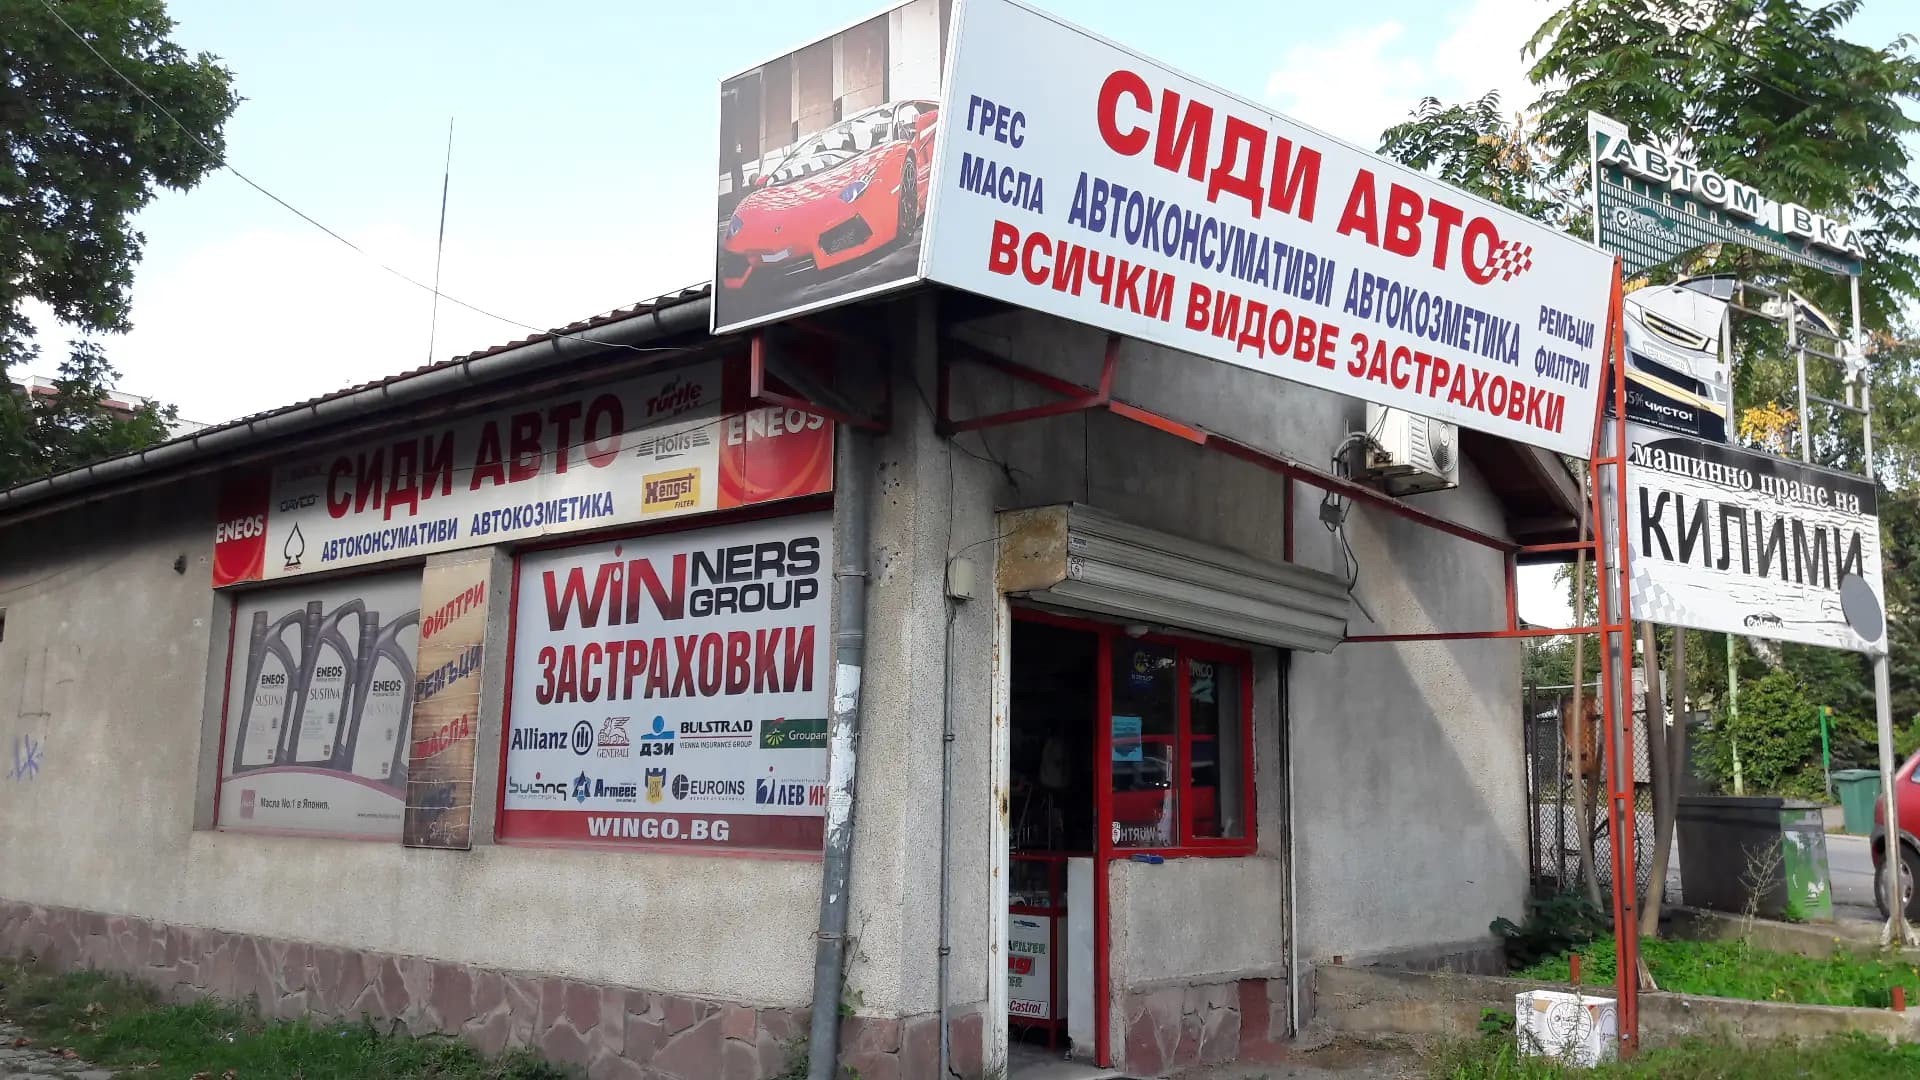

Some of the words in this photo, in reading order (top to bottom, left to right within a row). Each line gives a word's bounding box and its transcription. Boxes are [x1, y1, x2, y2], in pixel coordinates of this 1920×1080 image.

[966, 94, 1026, 149] ГРЕС
[959, 151, 1044, 214] МАСЛА
[1097, 69, 1322, 223] СИДИ
[1337, 168, 1504, 286] АВТО
[1068, 171, 1336, 308] АВТОКОНСУМАТИВИ
[1343, 267, 1520, 367] АВТОКОЗМЕТИКА
[988, 219, 1176, 323] ВСИЧКИ
[1185, 281, 1340, 370] ВИДОВЕ
[1347, 332, 1565, 434] ЗАСТРАХОВКИ
[1538, 304, 1596, 349] РЕМЪЦИ
[1534, 345, 1591, 390] ФИЛТРИ
[727, 406, 825, 447] ENEOS
[1645, 399, 1694, 422] ЧИСТО!
[326, 429, 455, 521] СИДИ
[469, 391, 625, 492] АВТО
[644, 472, 695, 505] Hengst
[1632, 442, 1753, 490] машинно
[1759, 472, 1829, 506] пране
[1833, 490, 1862, 515] на
[674, 499, 695, 510] FILTER
[215, 514, 264, 545] ENEOS
[321, 517, 458, 563] АВТОКОНСУМАТИВИ
[470, 490, 614, 537] АВТОКОЗМЕТИКА
[1638, 485, 1864, 592] КИЛИМИ
[423, 579, 486, 640] ФИЛТРИ
[689, 578, 819, 618] GROUP
[261, 673, 286, 686] ENEOS
[316, 665, 343, 678] ENEOS
[414, 645, 484, 702] РЕМЪЦИ
[535, 624, 816, 705] ЗАСТРАХОВКИ
[309, 687, 341, 701] SUSTINA
[372, 678, 402, 692] ENEOS
[511, 727, 568, 751] Allianz
[680, 720, 753, 734] BULSTRAD
[639, 742, 675, 757] ДЗИ
[260, 796, 281, 809] Масла
[593, 778, 637, 798] Armeec
[690, 780, 745, 796] EUROINS
[776, 784, 805, 806] ЛЕВ
[587, 816, 730, 841] WINGO.BG
[1009, 999, 1042, 1015] Castrol
